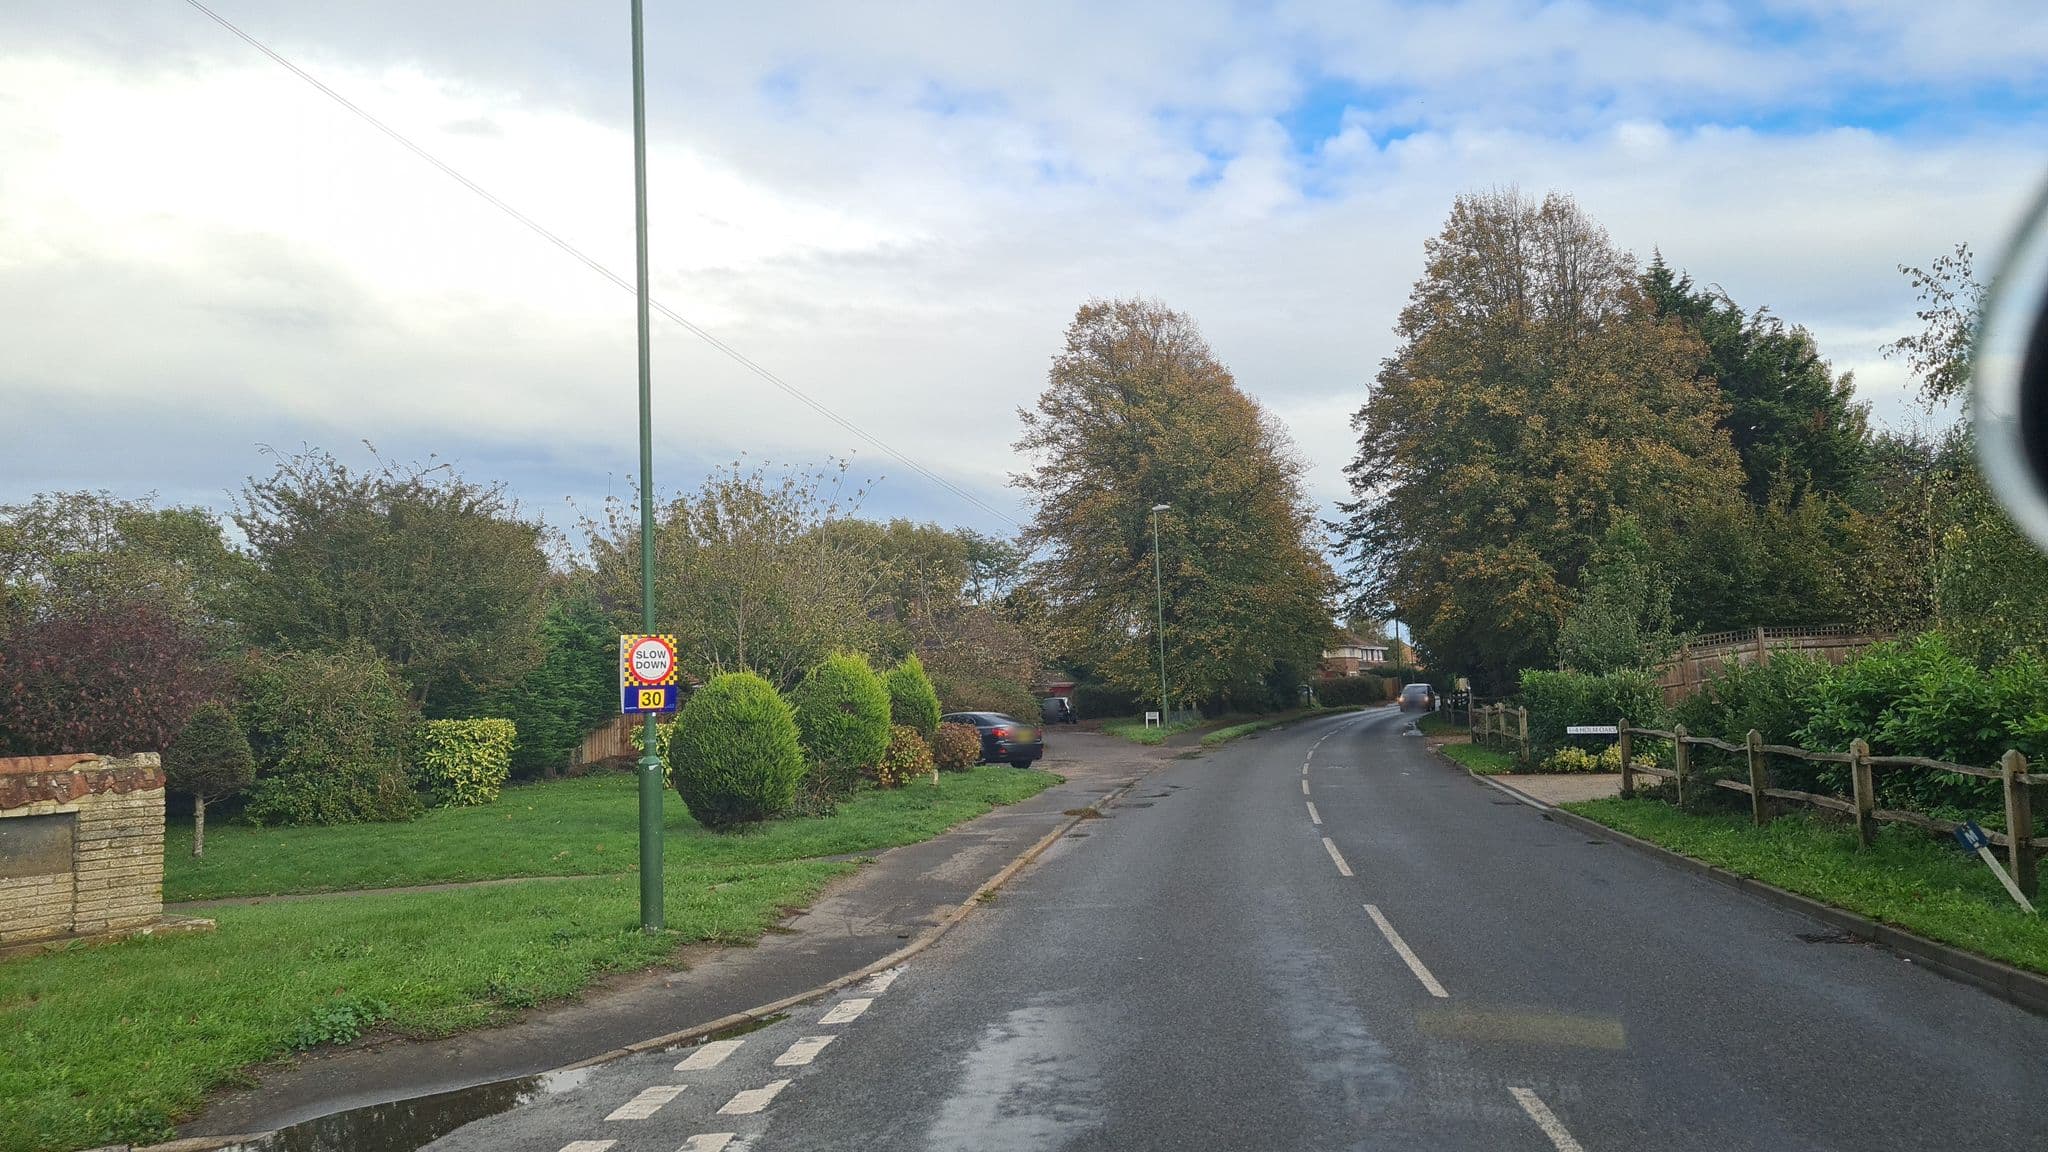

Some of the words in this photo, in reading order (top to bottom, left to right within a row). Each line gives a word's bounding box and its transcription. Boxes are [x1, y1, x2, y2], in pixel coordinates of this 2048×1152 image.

[636, 650, 666, 659] SLOW
[636, 661, 667, 669] DOWN
[642, 692, 661, 706] 30
